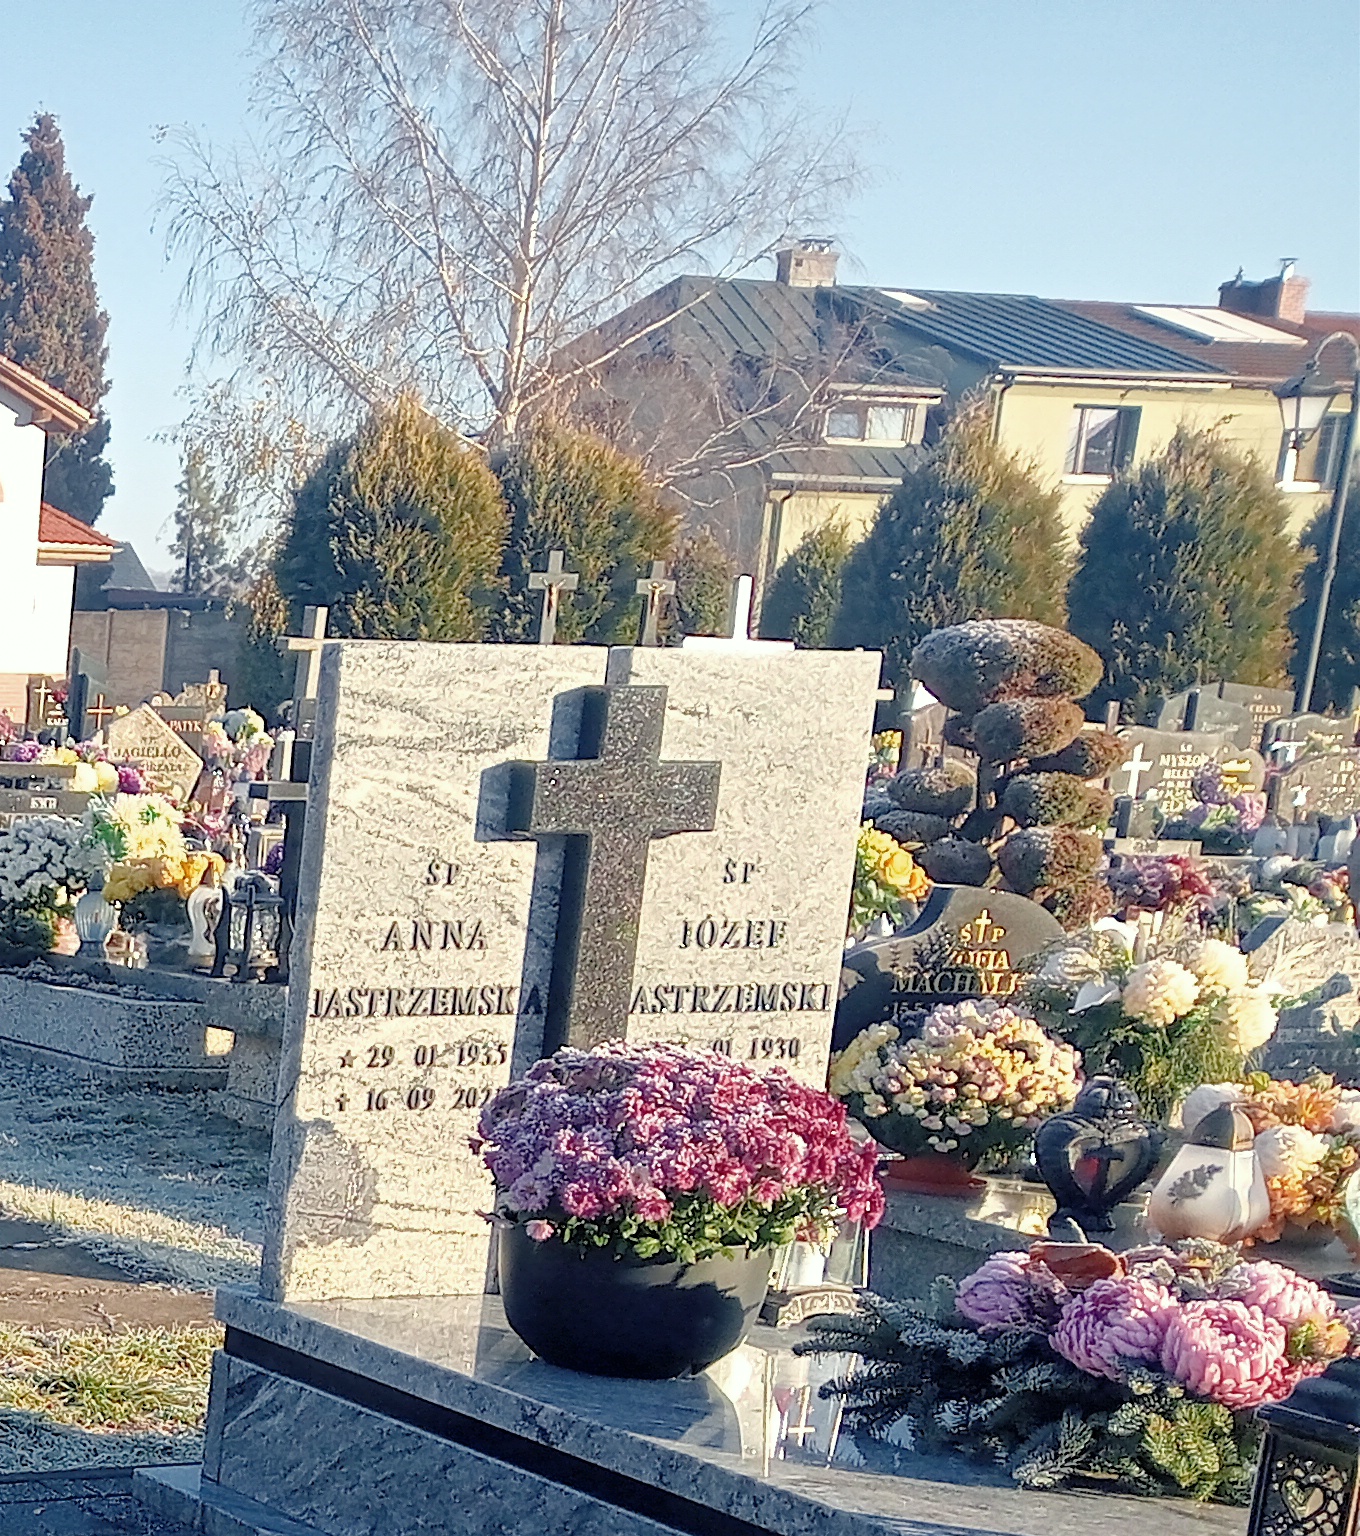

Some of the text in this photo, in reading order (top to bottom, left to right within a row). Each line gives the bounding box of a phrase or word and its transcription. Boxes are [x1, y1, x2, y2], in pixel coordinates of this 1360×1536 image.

[381, 920, 489, 951] ANNA
[630, 982, 833, 1014] ASTRZEMSKI
[366, 1044, 395, 1068] 29
[406, 1087, 436, 1111] 09
[451, 1085, 506, 1109] 202
